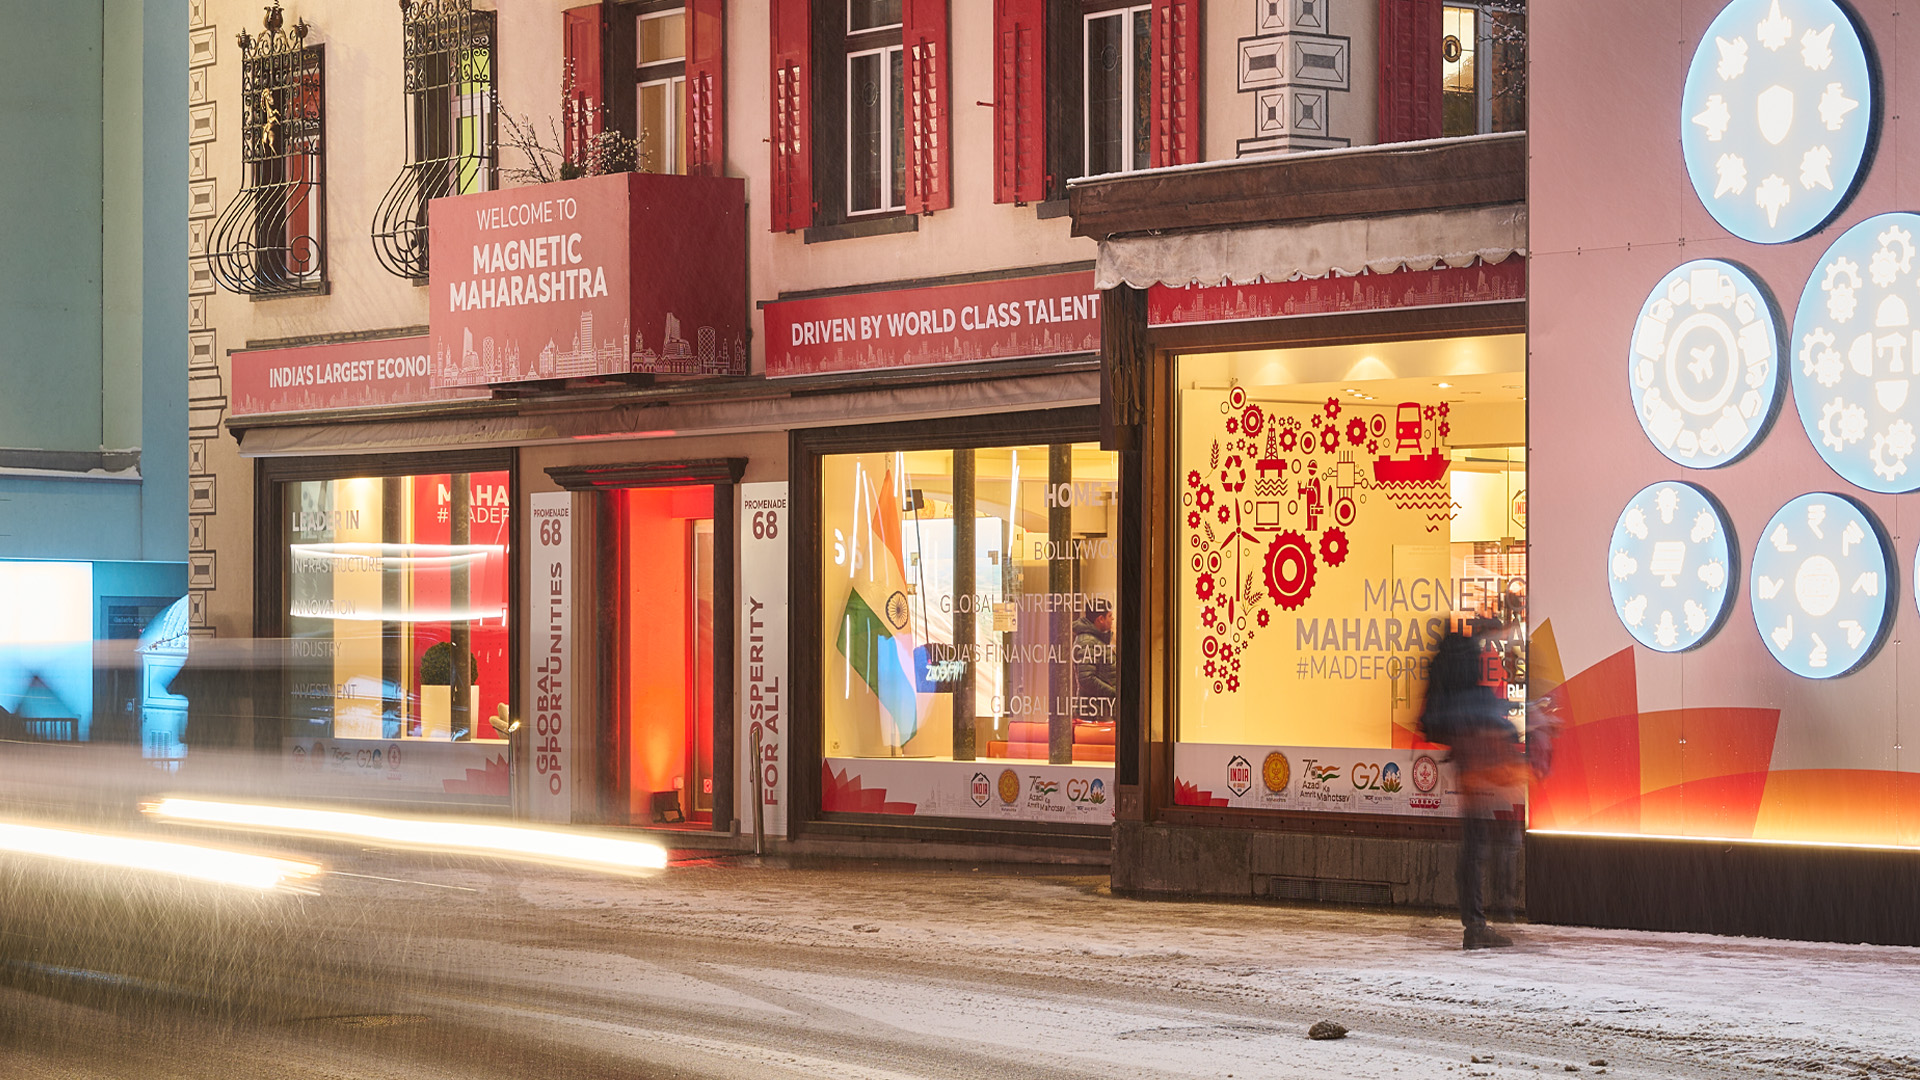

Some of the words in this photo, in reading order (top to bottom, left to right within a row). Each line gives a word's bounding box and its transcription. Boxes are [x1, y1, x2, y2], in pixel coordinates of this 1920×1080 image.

[476, 201, 553, 231] WELCOME
[557, 197, 577, 220] TO
[473, 233, 582, 275] MAGNETIC
[450, 266, 608, 312] MAHARASHTRA
[791, 317, 855, 346] DRIVEN
[861, 314, 883, 340] BY
[887, 308, 956, 337] WORLD
[961, 301, 1021, 331] CLASS
[1024, 294, 1099, 325] TALENT
[269, 365, 313, 388] INDIA'S
[317, 360, 374, 384] LARGEST
[377, 355, 430, 381] ECONO
[744, 499, 787, 509] PROMENADE
[1044, 482, 1104, 508] HOME
[292, 510, 342, 531] LEADER
[346, 510, 359, 530] IN
[437, 507, 509, 523] #DEF
[533, 508, 569, 518] PROMENADE
[752, 510, 778, 540] 68
[540, 519, 562, 546] 68
[292, 556, 382, 574] INFRASTRUCTURE
[292, 599, 356, 615] INNOVATION
[940, 594, 999, 613] GLOBAL
[1004, 592, 1115, 613] ENTREPRENEU
[1364, 577, 1526, 612] MAGNETIC
[292, 641, 342, 657] INDUSTRY
[931, 643, 981, 663] INDIA'S
[985, 644, 1066, 663] FINANCIAL
[1071, 644, 1116, 664] CAPIT
[549, 561, 563, 796] OPPORTUNITIES
[749, 595, 764, 783] OSPERITY
[292, 684, 357, 700] INVESTMENT
[764, 676, 779, 734] ALL
[536, 657, 549, 775] GLOBAL
[991, 695, 1051, 715] GLOBAL
[1056, 696, 1116, 717] LIFESTY
[764, 743, 779, 805] FOR
[1230, 768, 1249, 782] INDIA
[1352, 762, 1403, 793] G20
[973, 782, 988, 795] INDIA
[1066, 778, 1106, 804] G20
[1410, 798, 1442, 806] MIDC
